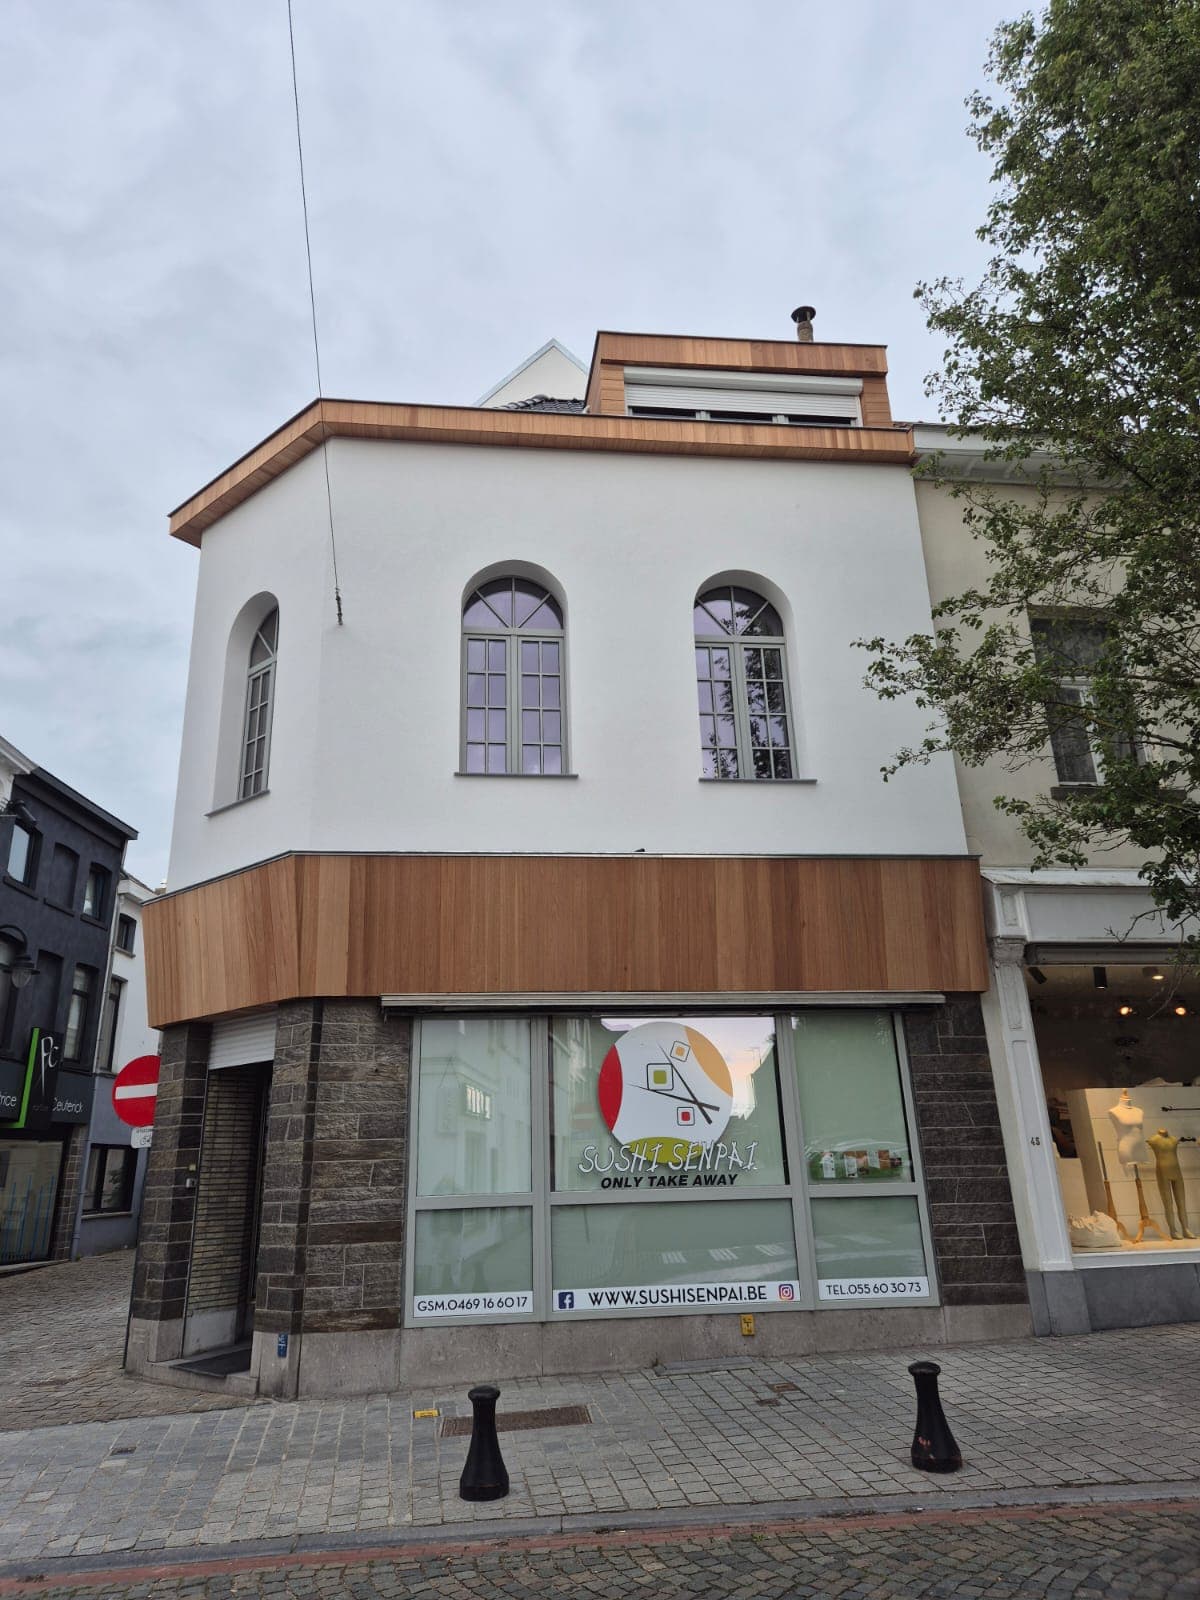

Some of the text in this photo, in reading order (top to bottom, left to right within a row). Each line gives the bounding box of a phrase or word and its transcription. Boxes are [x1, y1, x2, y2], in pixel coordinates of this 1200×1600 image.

[578, 1140, 758, 1173] SUSHI SENPAI
[601, 1173, 738, 1189] ONLY TAKE AWAY
[588, 1285, 768, 1306] WWW.SUSHISENPAI.BE
